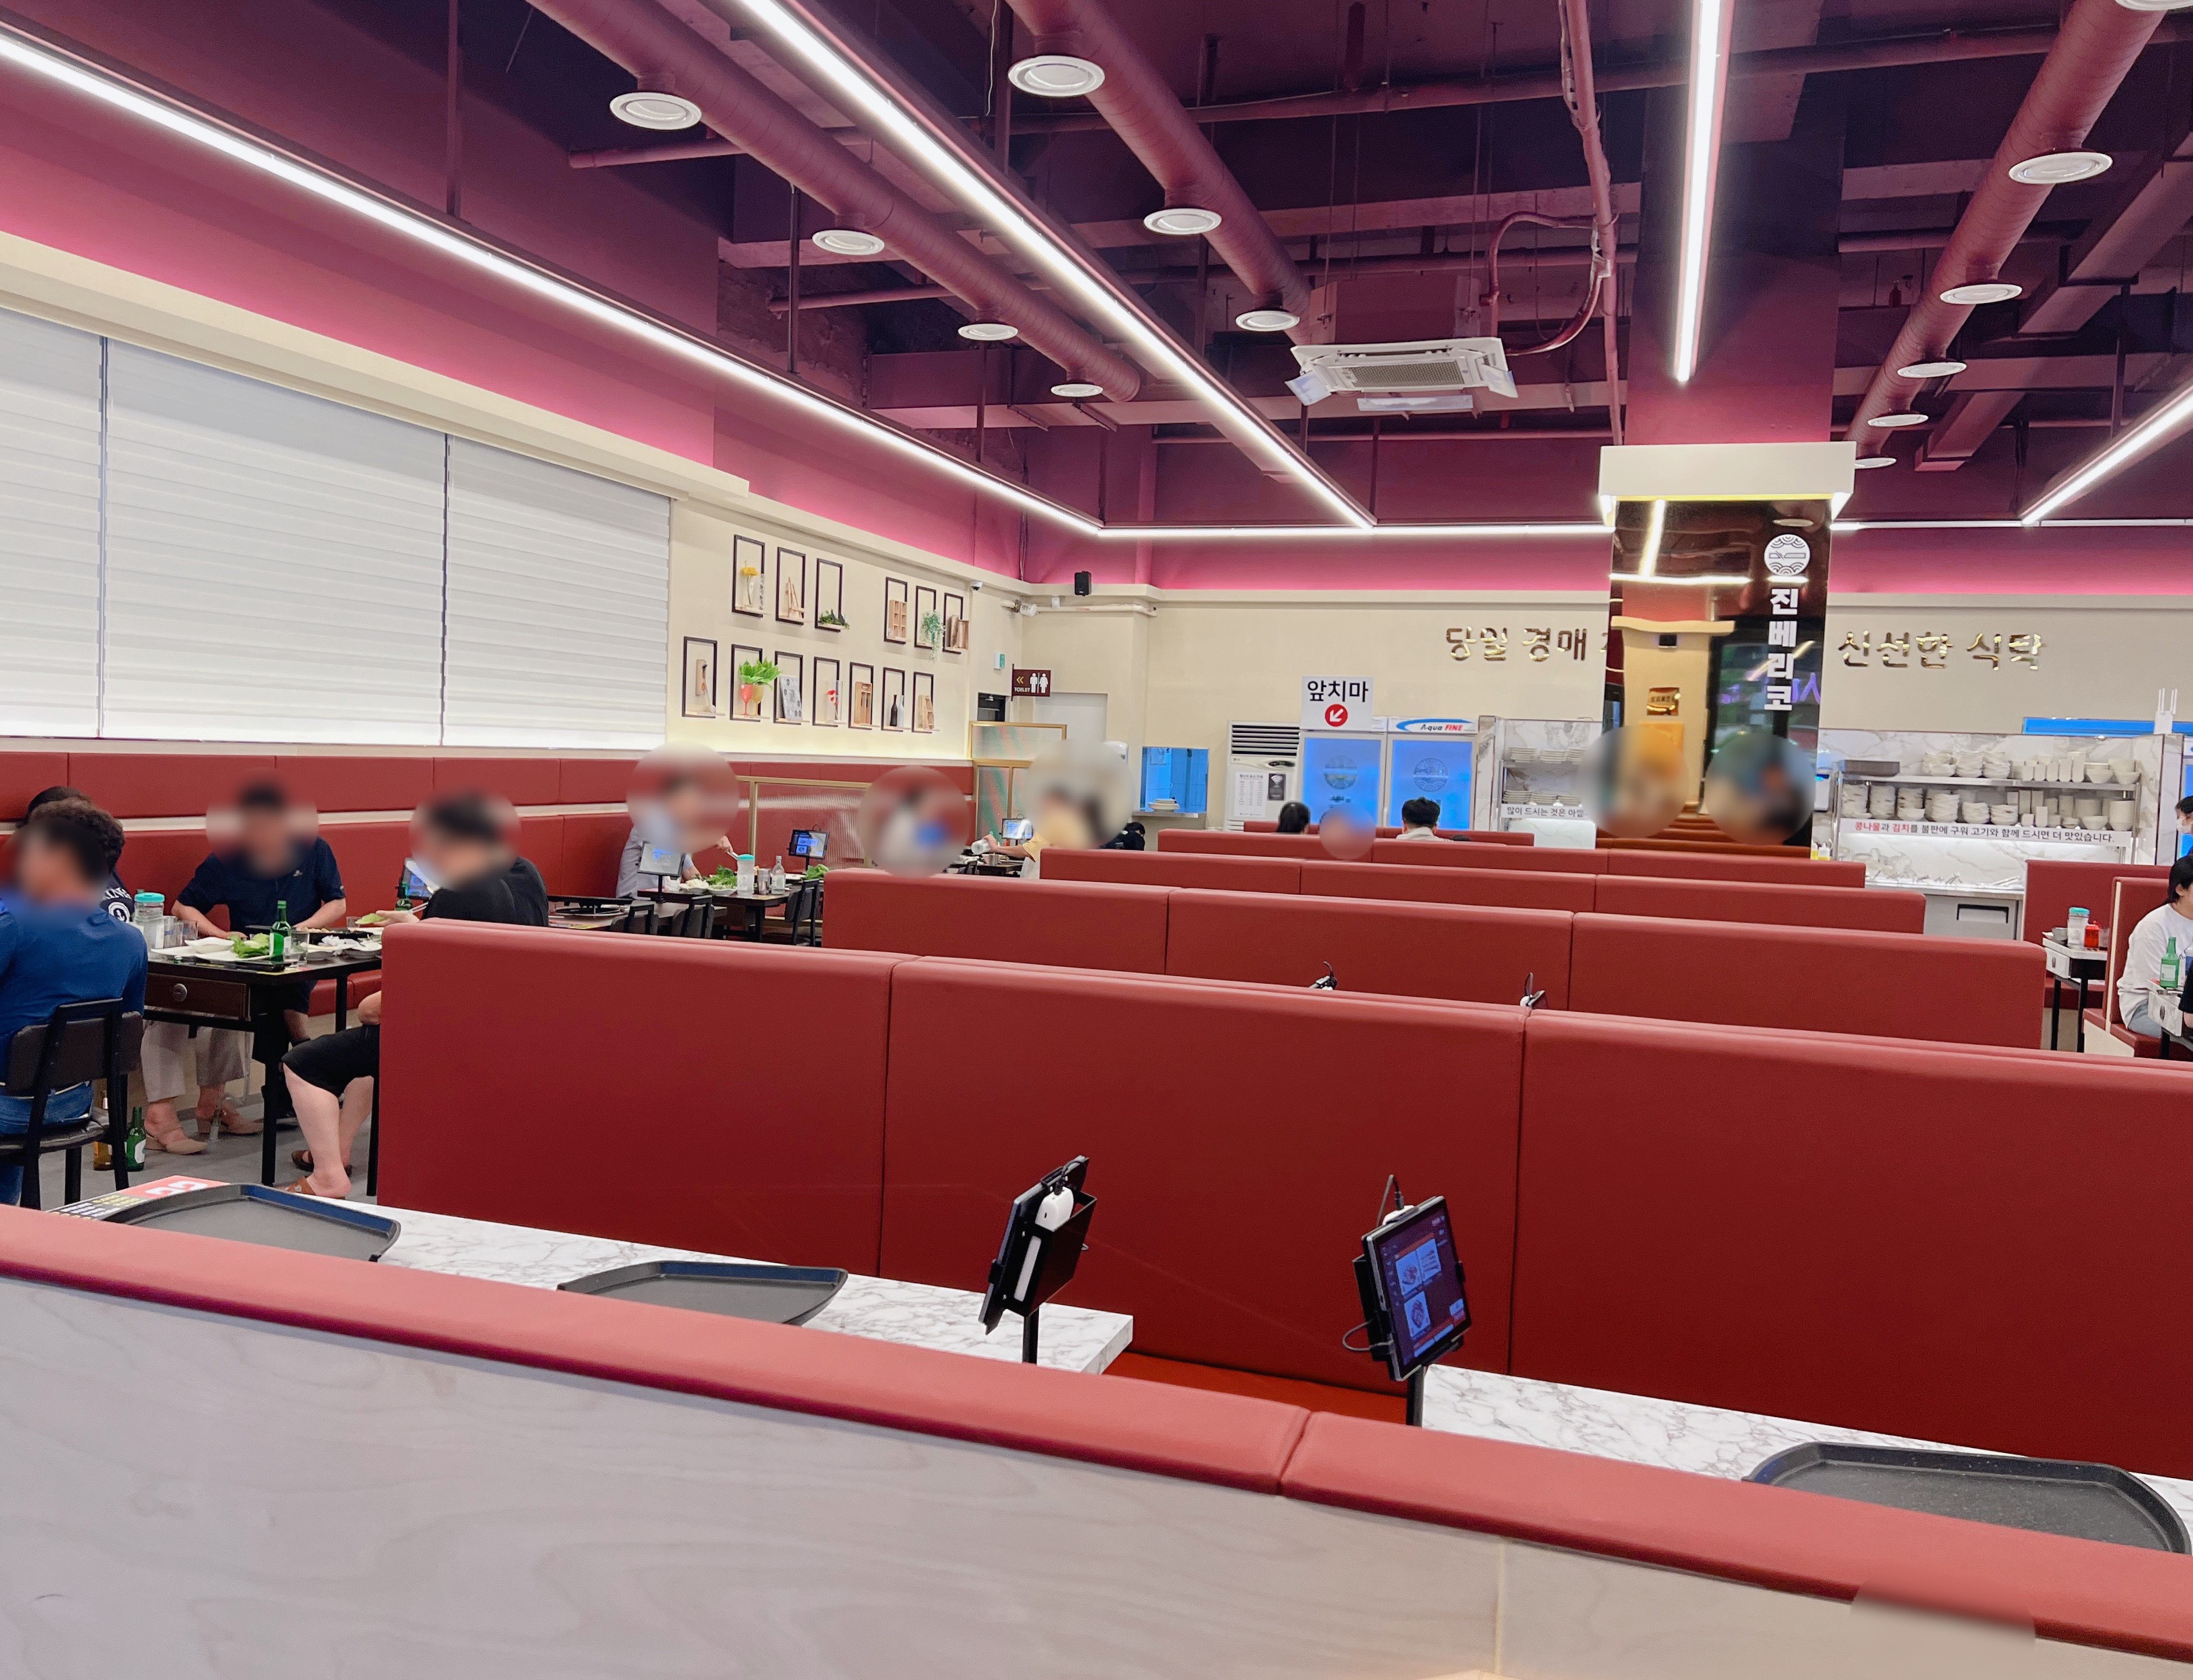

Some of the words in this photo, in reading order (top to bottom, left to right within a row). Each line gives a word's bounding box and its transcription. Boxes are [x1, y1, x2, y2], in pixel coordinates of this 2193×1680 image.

[1446, 627, 1507, 661] 당일
[1522, 627, 1587, 662] 경매
[1764, 588, 1799, 711] 진베리코
[1838, 631, 1953, 669] 신선한
[1967, 633, 2046, 671] 식탁
[1307, 680, 1369, 702] 앞치마
[1507, 807, 1522, 815] 많이
[1524, 807, 1548, 817] 드시는
[1550, 808, 1566, 817] 것은
[1856, 821, 1889, 832] 콩나물과
[1892, 824, 1918, 833] 김치를
[1921, 825, 1948, 835] 불판에
[1950, 826, 1968, 836] 구워
[1970, 827, 1999, 838] 고기와
[2002, 828, 2020, 838] 함께
[2053, 831, 2062, 841] 더
